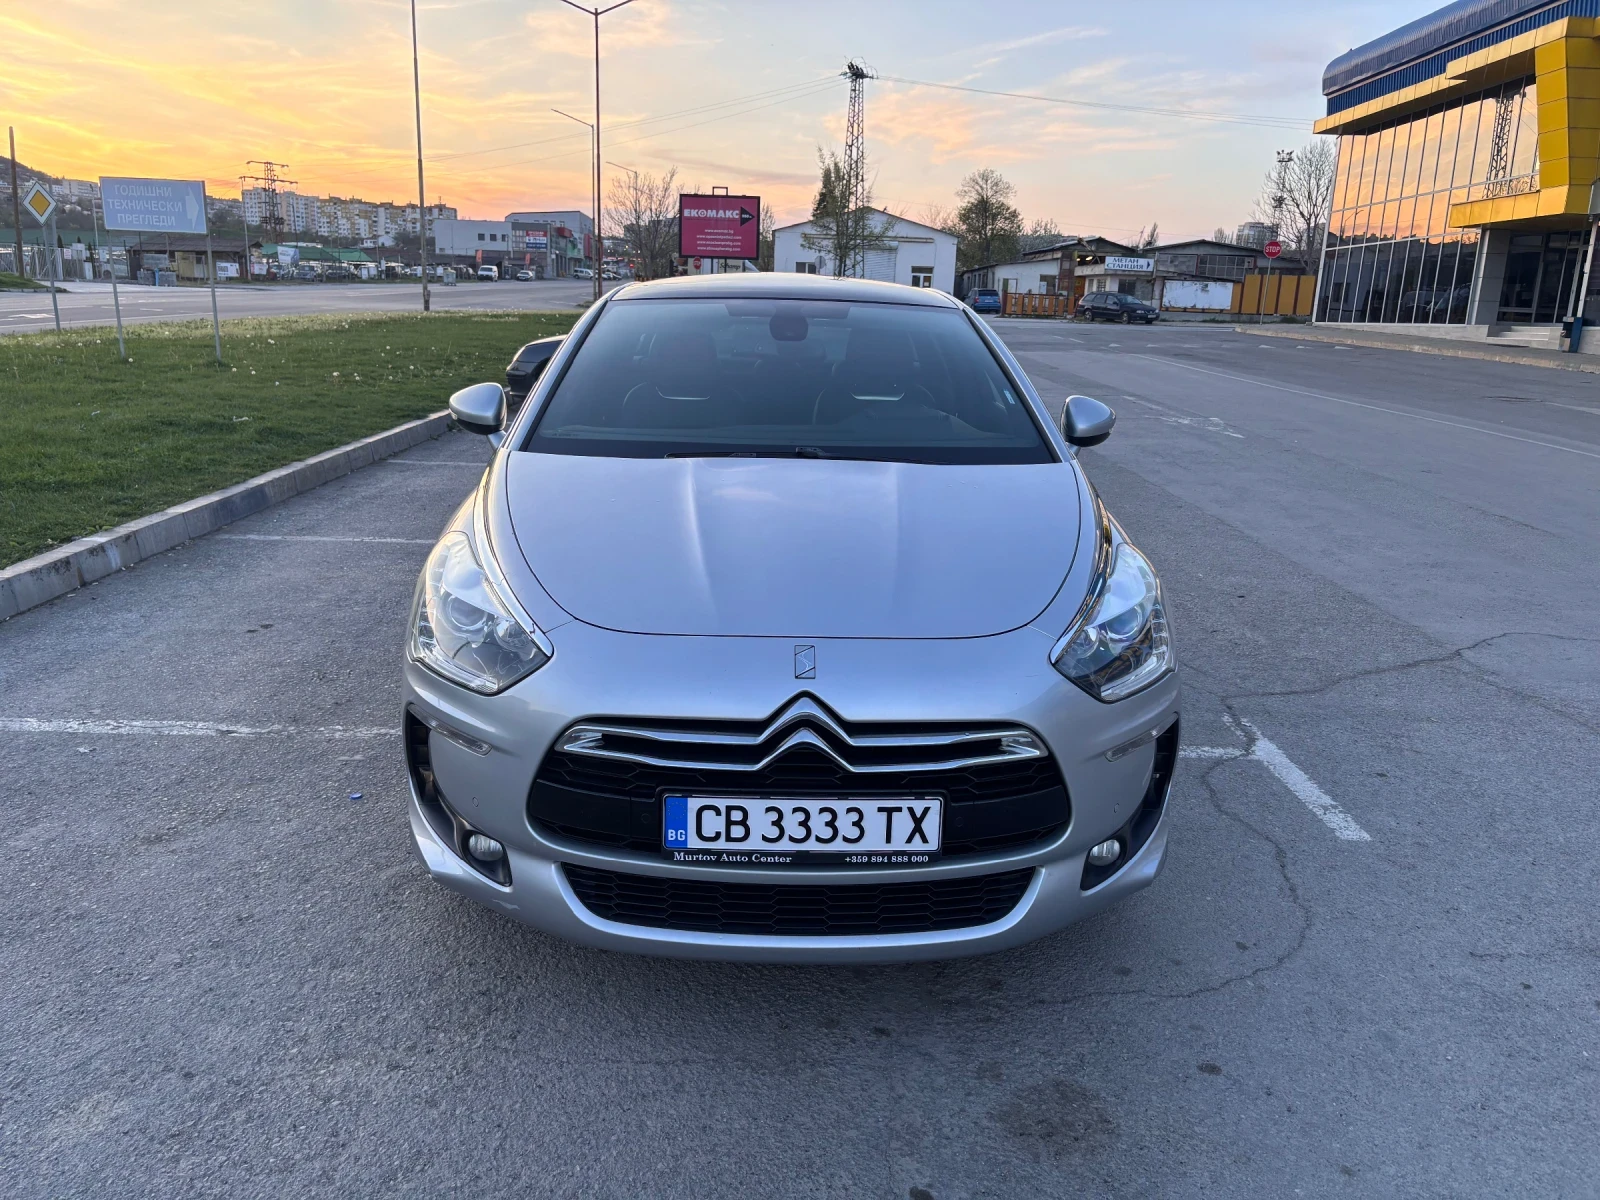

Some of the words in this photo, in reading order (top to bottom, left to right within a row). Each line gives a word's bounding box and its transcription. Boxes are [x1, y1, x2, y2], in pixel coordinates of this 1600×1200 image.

[114, 184, 172, 197] ГОДИШНИ
[107, 198, 183, 212] ТЕХНИЧЕСКИ
[683, 208, 740, 219] ЕКОМАКС
[117, 213, 176, 227] ПРЕГЛЕДИ
[1265, 245, 1281, 253] STOP
[1106, 262, 1144, 270] СТАНЦИЯ
[695, 804, 751, 843] CB
[761, 805, 865, 844] 3333
[877, 806, 931, 844] TX
[668, 829, 686, 841] BG
[673, 851, 717, 861] Murtov
[720, 852, 749, 862] Auto
[752, 854, 792, 863] Center
[845, 855, 868, 863] +359
[871, 855, 888, 863] 894
[891, 855, 909, 863] 888
[911, 855, 929, 863] 000
